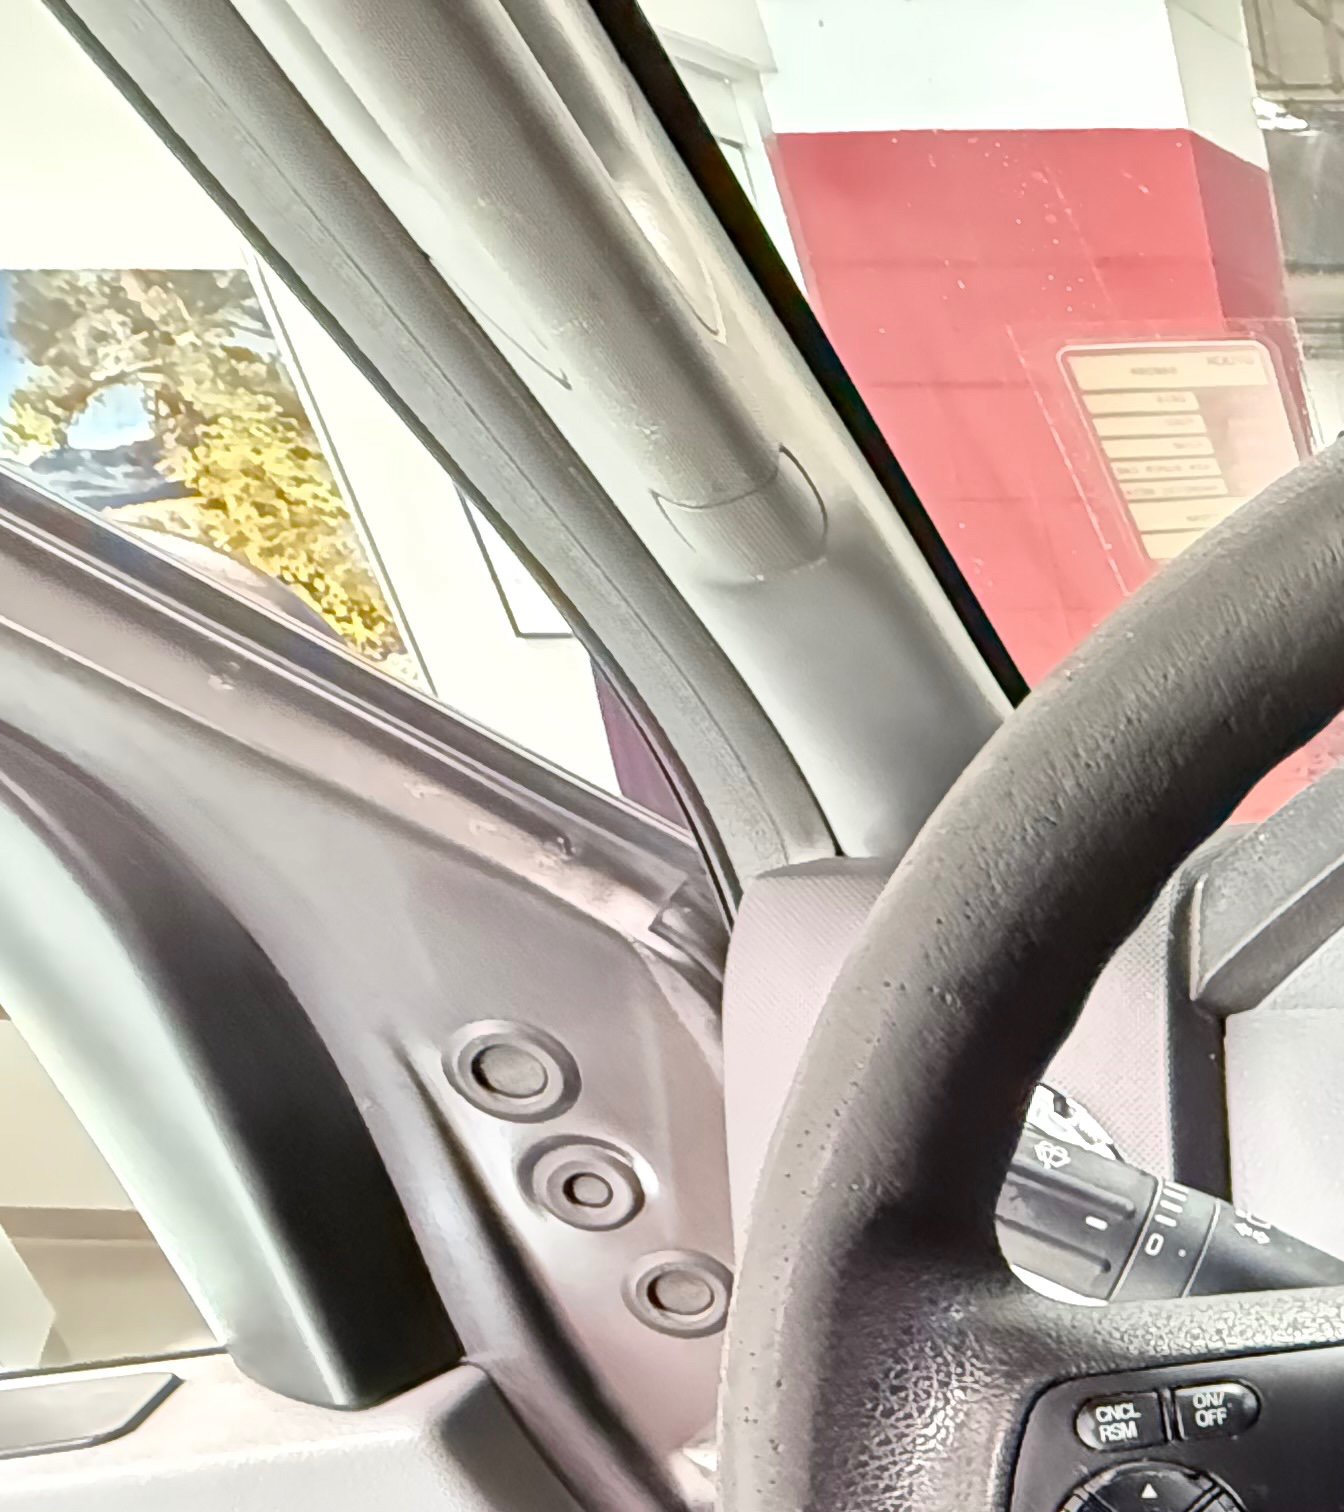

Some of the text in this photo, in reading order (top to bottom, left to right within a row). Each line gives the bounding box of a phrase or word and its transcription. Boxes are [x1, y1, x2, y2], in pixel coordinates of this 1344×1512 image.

[1095, 1402, 1141, 1422] CNCL
[1195, 1408, 1228, 1428] OFF
[1099, 1420, 1138, 1442] RSM
